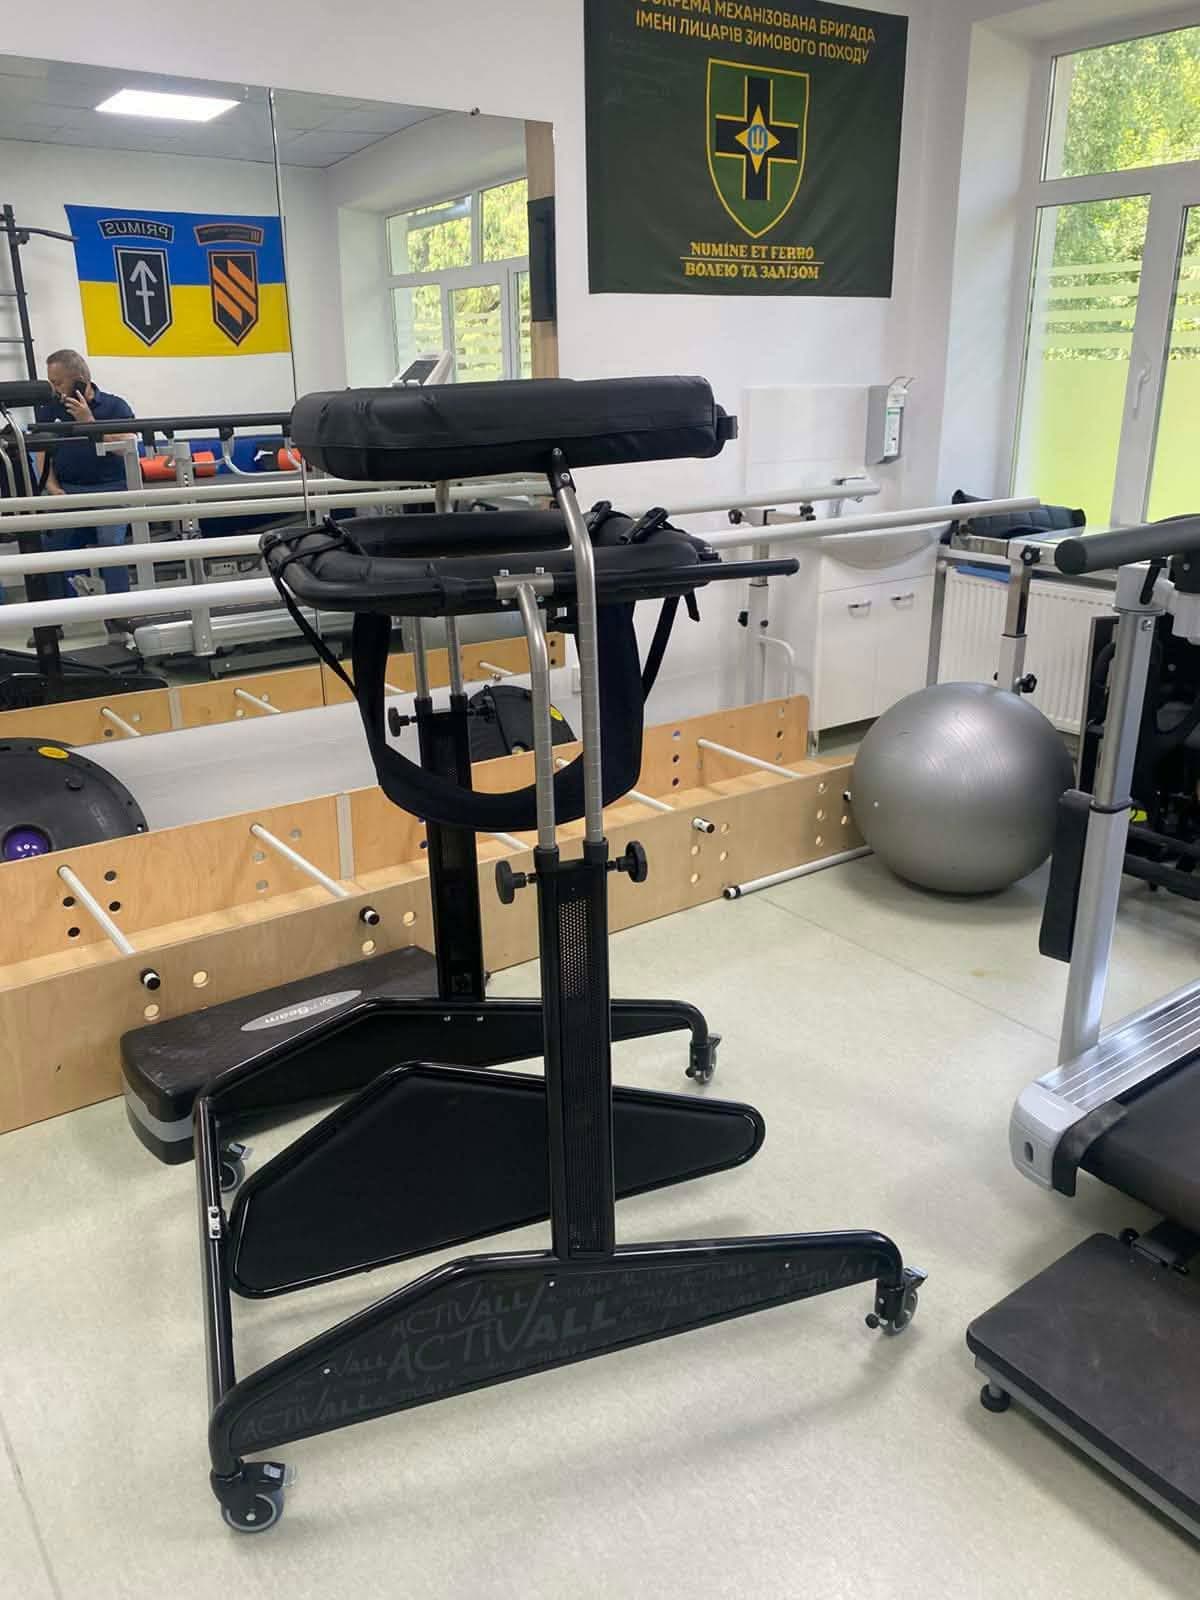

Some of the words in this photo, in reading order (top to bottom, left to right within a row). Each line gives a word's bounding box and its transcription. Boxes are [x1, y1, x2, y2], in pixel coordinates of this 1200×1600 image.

[635, 8, 676, 33] ІМЕНІ
[679, 18, 743, 41] ЛИЦАРІВ
[744, 28, 817, 56] ЗИМОВОГО
[818, 41, 870, 65] ПОХОДУ
[714, 1, 817, 33] МЕХАНІЗОВАНА
[819, 18, 876, 42] БРИГАДА
[685, 261, 739, 278] ВОЛЕЮ
[741, 264, 758, 279] ТА
[760, 264, 819, 280] ЗАЛІЗОМ
[690, 241, 748, 258] NUMINE
[751, 244, 769, 259] ET
[387, 1281, 617, 1380] ACTIVALL
